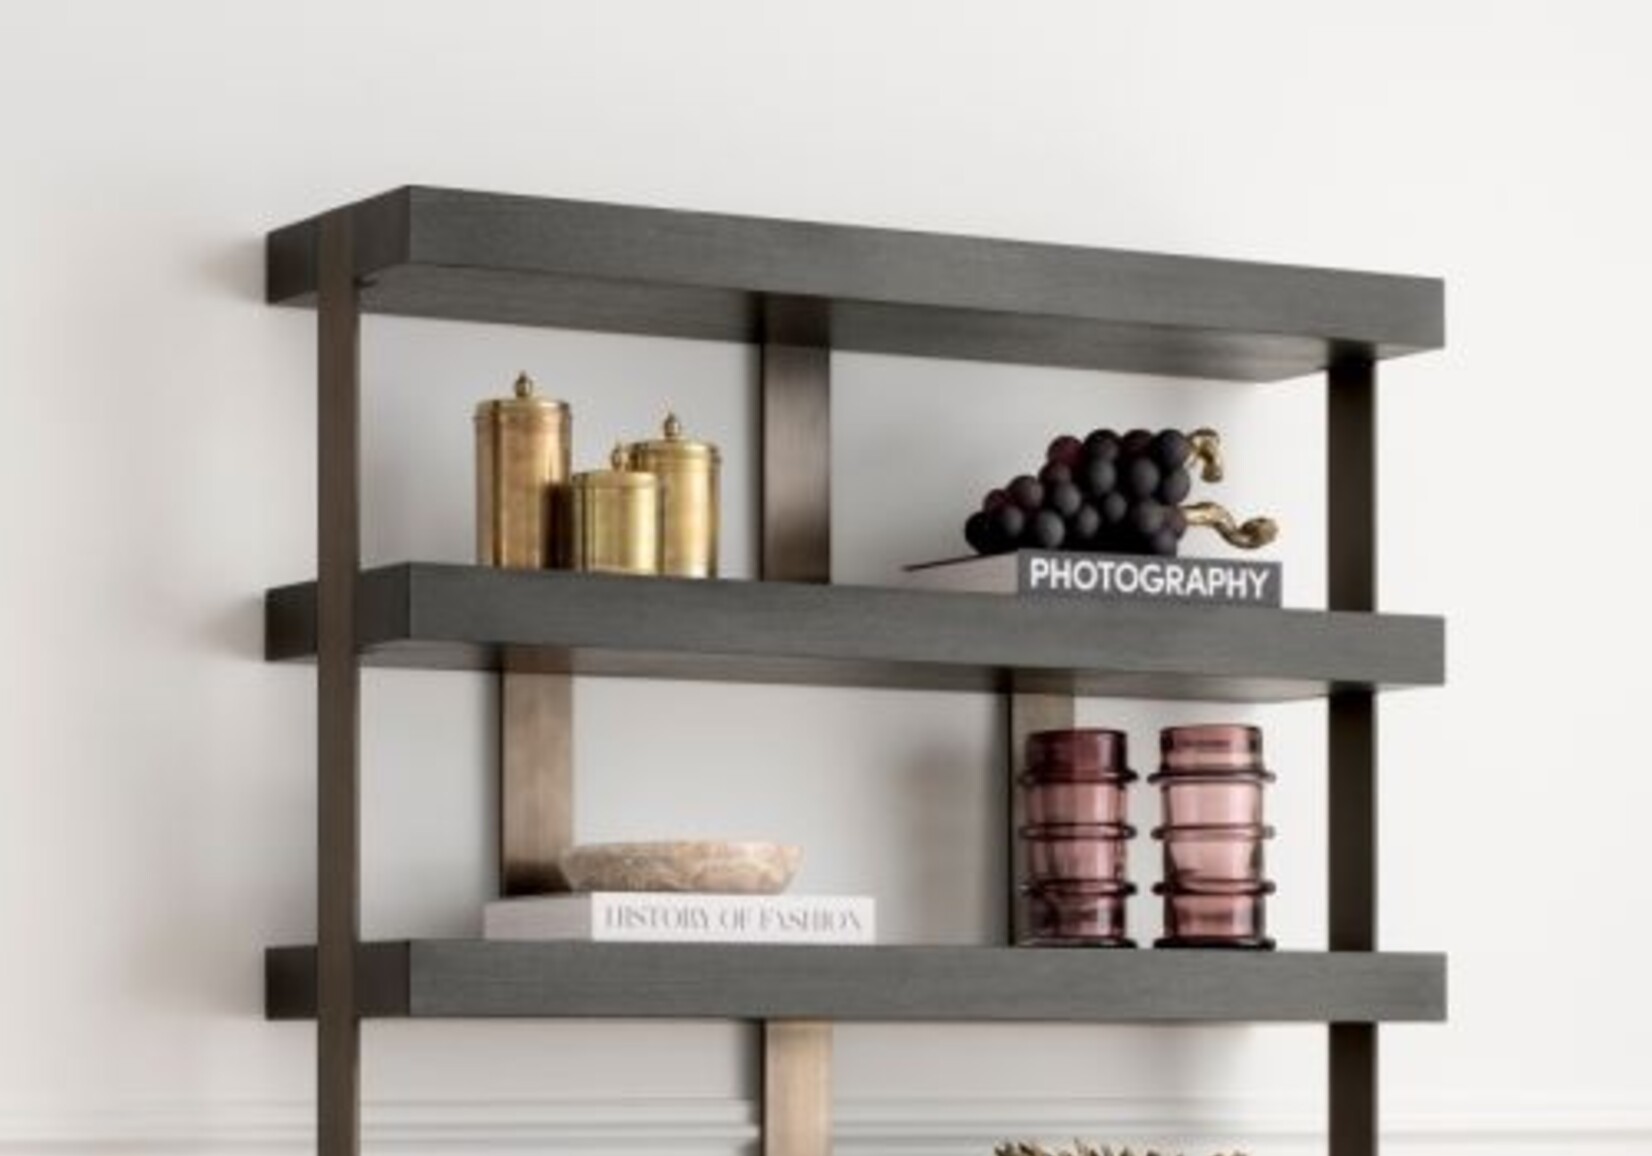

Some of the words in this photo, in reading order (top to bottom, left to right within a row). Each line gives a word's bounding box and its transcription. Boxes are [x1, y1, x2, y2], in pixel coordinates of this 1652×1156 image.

[1030, 558, 1268, 599] PHOTOGRAPHY
[605, 905, 709, 929] HISTORY
[719, 907, 748, 931] OF
[760, 908, 862, 932] FASHION
